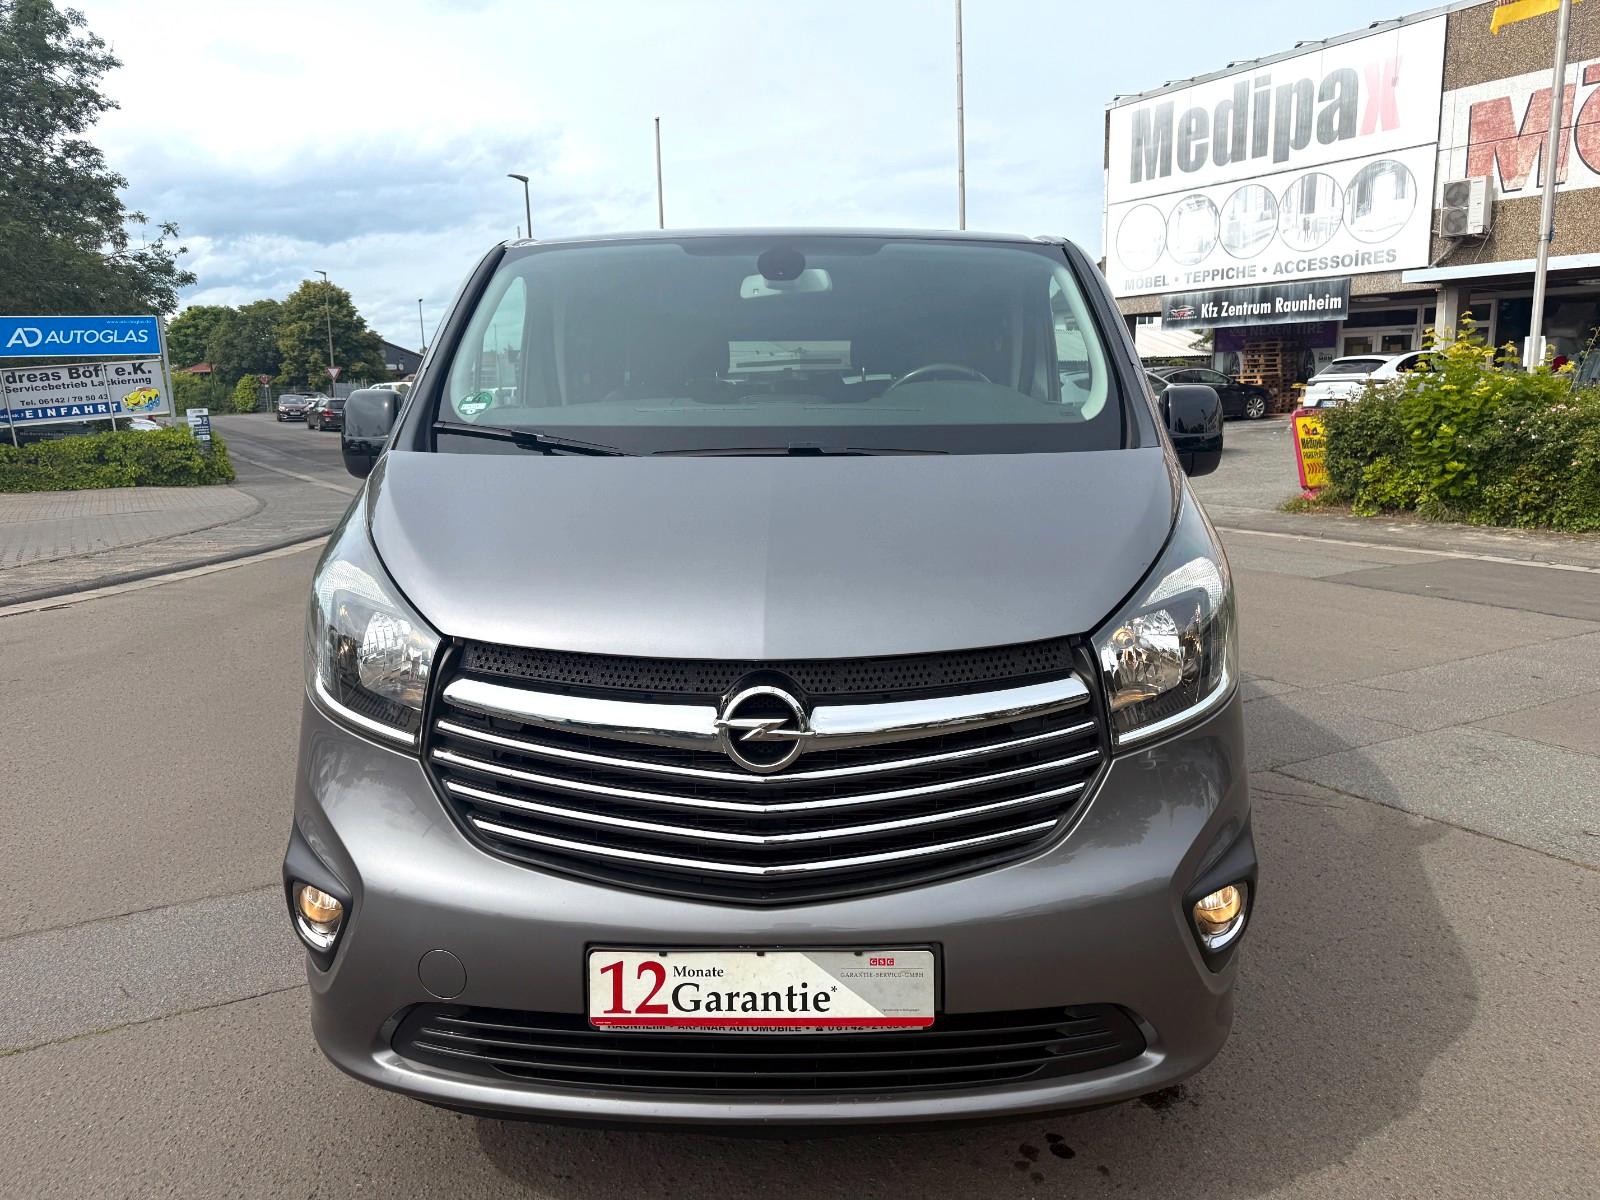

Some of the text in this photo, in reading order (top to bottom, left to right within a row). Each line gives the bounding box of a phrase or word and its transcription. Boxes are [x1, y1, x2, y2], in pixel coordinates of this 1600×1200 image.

[1130, 56, 1403, 184] Medipax
[1184, 265, 1257, 284] TEPPICHE
[1201, 294, 1342, 318] Kfz Zentrum Raunheim
[6, 327, 149, 348] AD AUTOGLAS
[115, 362, 152, 376] e.K.
[91, 377, 152, 388] Lackierung
[20, 399, 37, 407] Tel.
[39, 397, 65, 405] 06142
[25, 402, 118, 419] EINFAHRT
[599, 960, 724, 1014] 12 Monate
